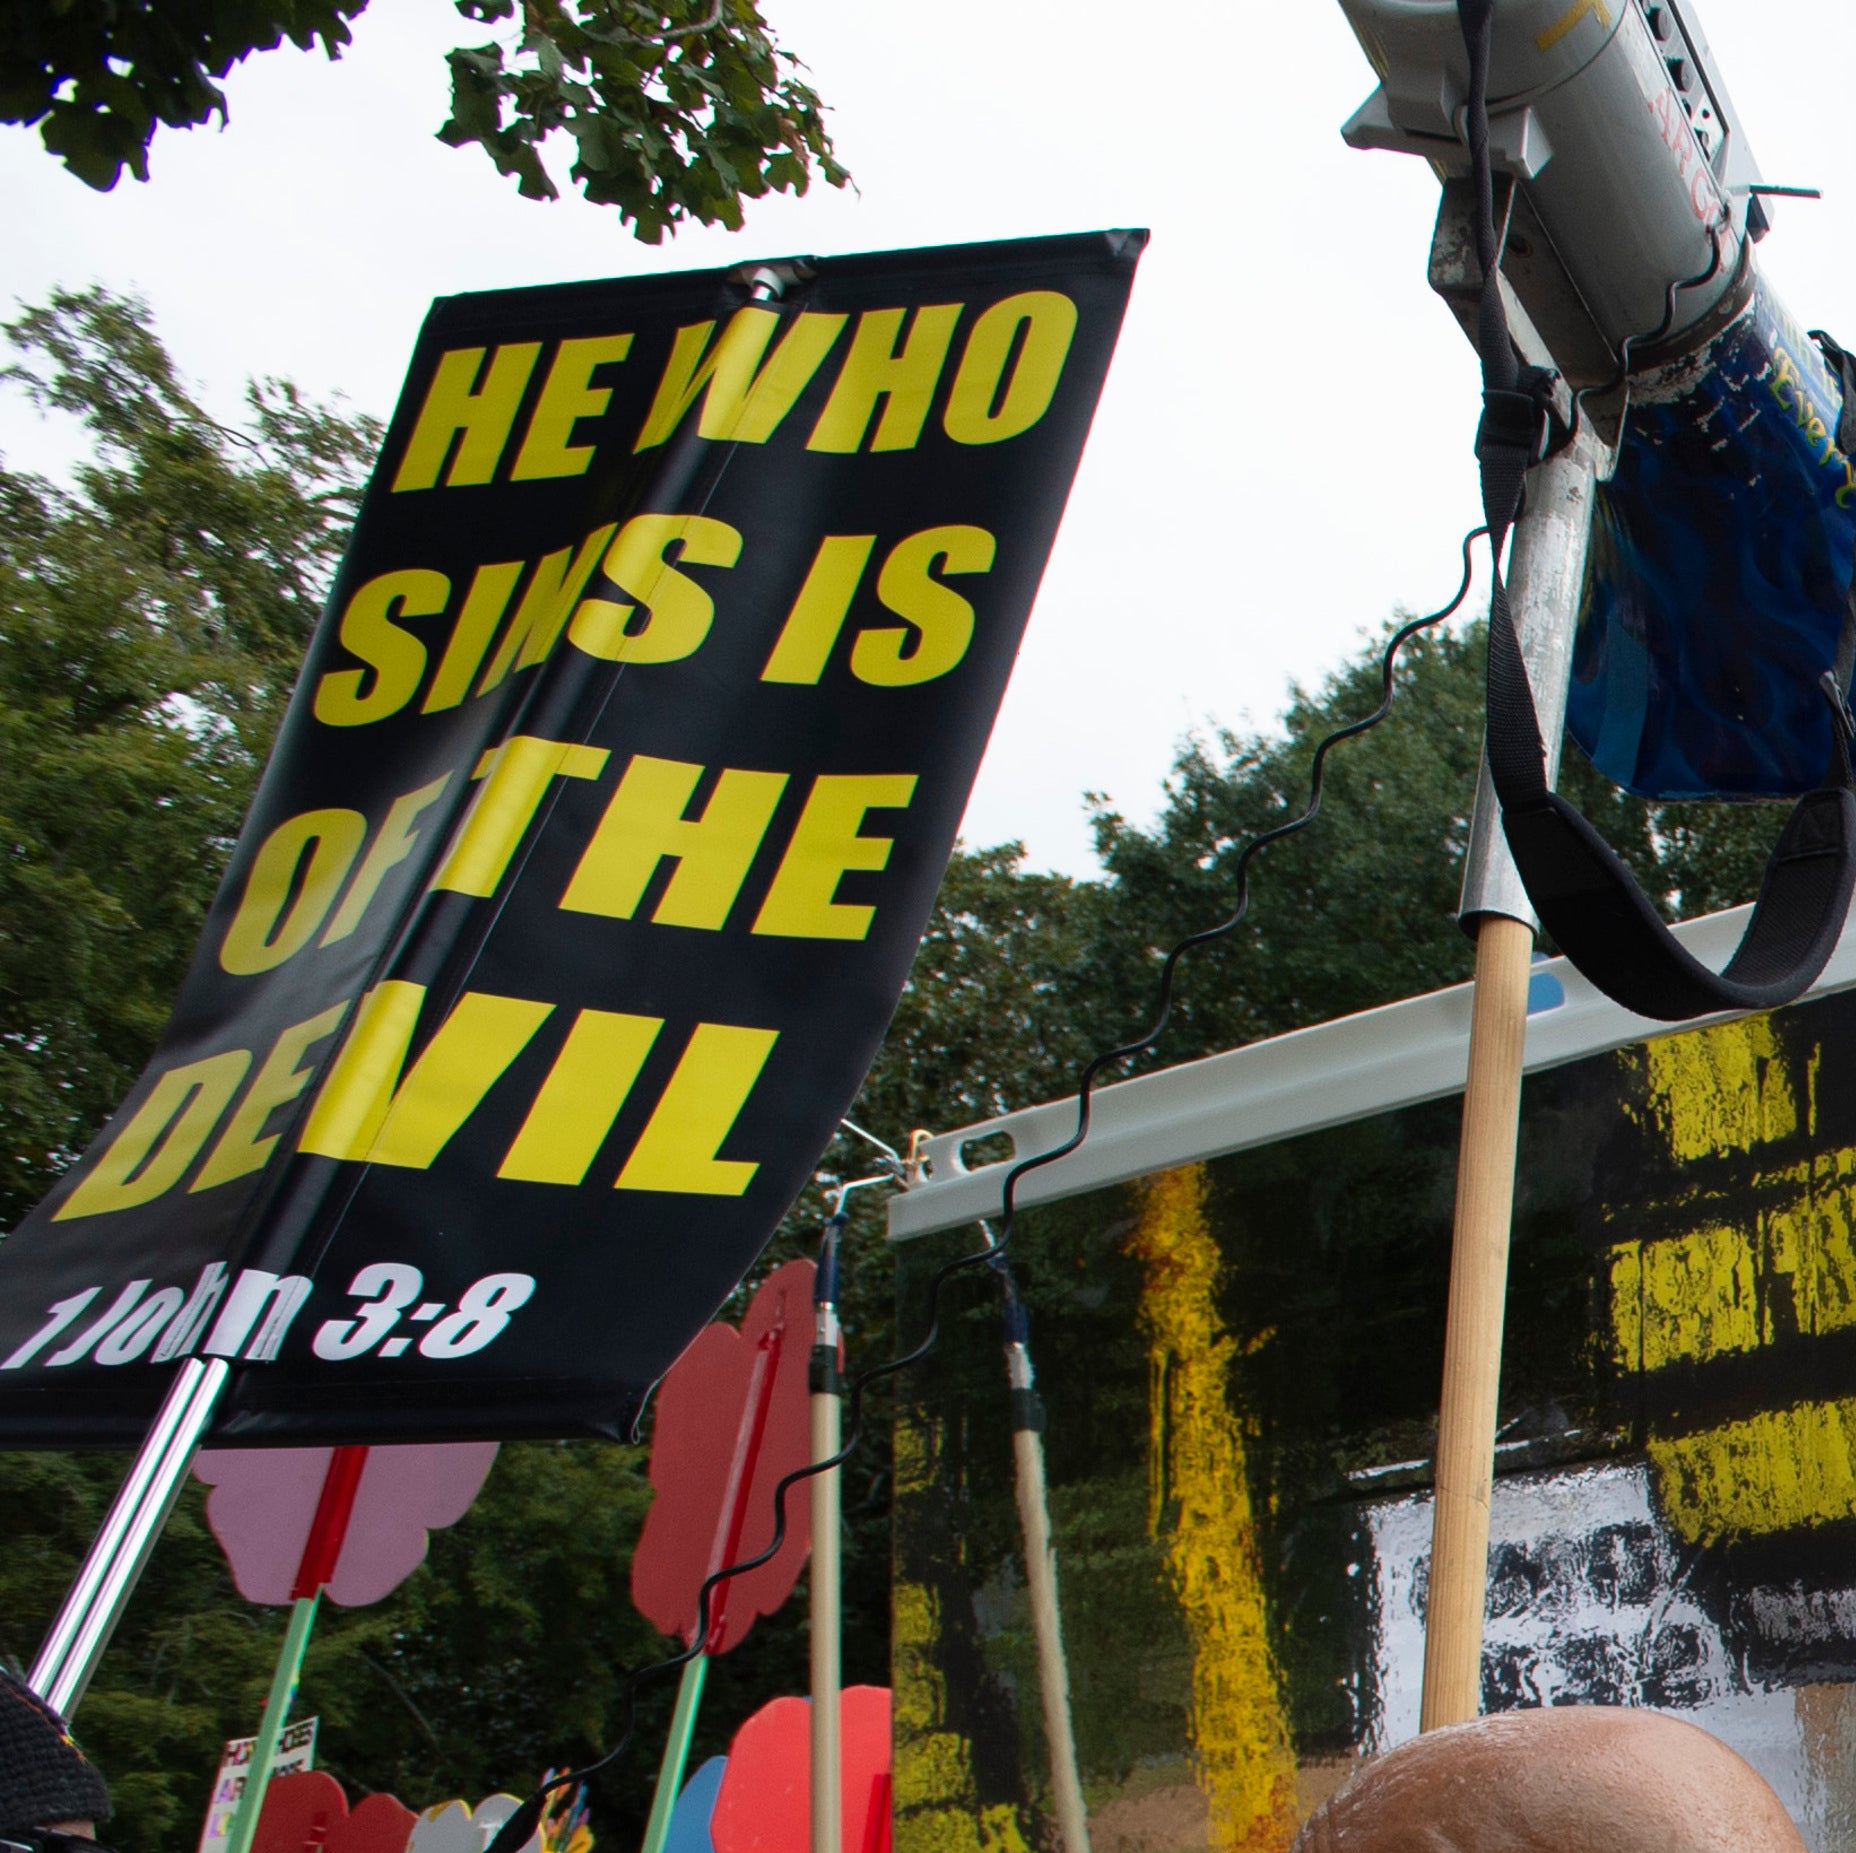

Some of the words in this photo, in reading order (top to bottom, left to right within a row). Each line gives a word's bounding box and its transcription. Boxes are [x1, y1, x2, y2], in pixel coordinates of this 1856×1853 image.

[391, 334, 633, 493] HE
[633, 290, 1078, 455] WHO
[311, 513, 743, 728] SINS
[760, 524, 996, 688] IS
[218, 771, 457, 977] OF
[428, 736, 920, 941] THE
[49, 979, 780, 1222] DEVIL
[0, 1286, 103, 1370] 1
[44, 1261, 314, 1367] John
[312, 1262, 537, 1361] 3:8
